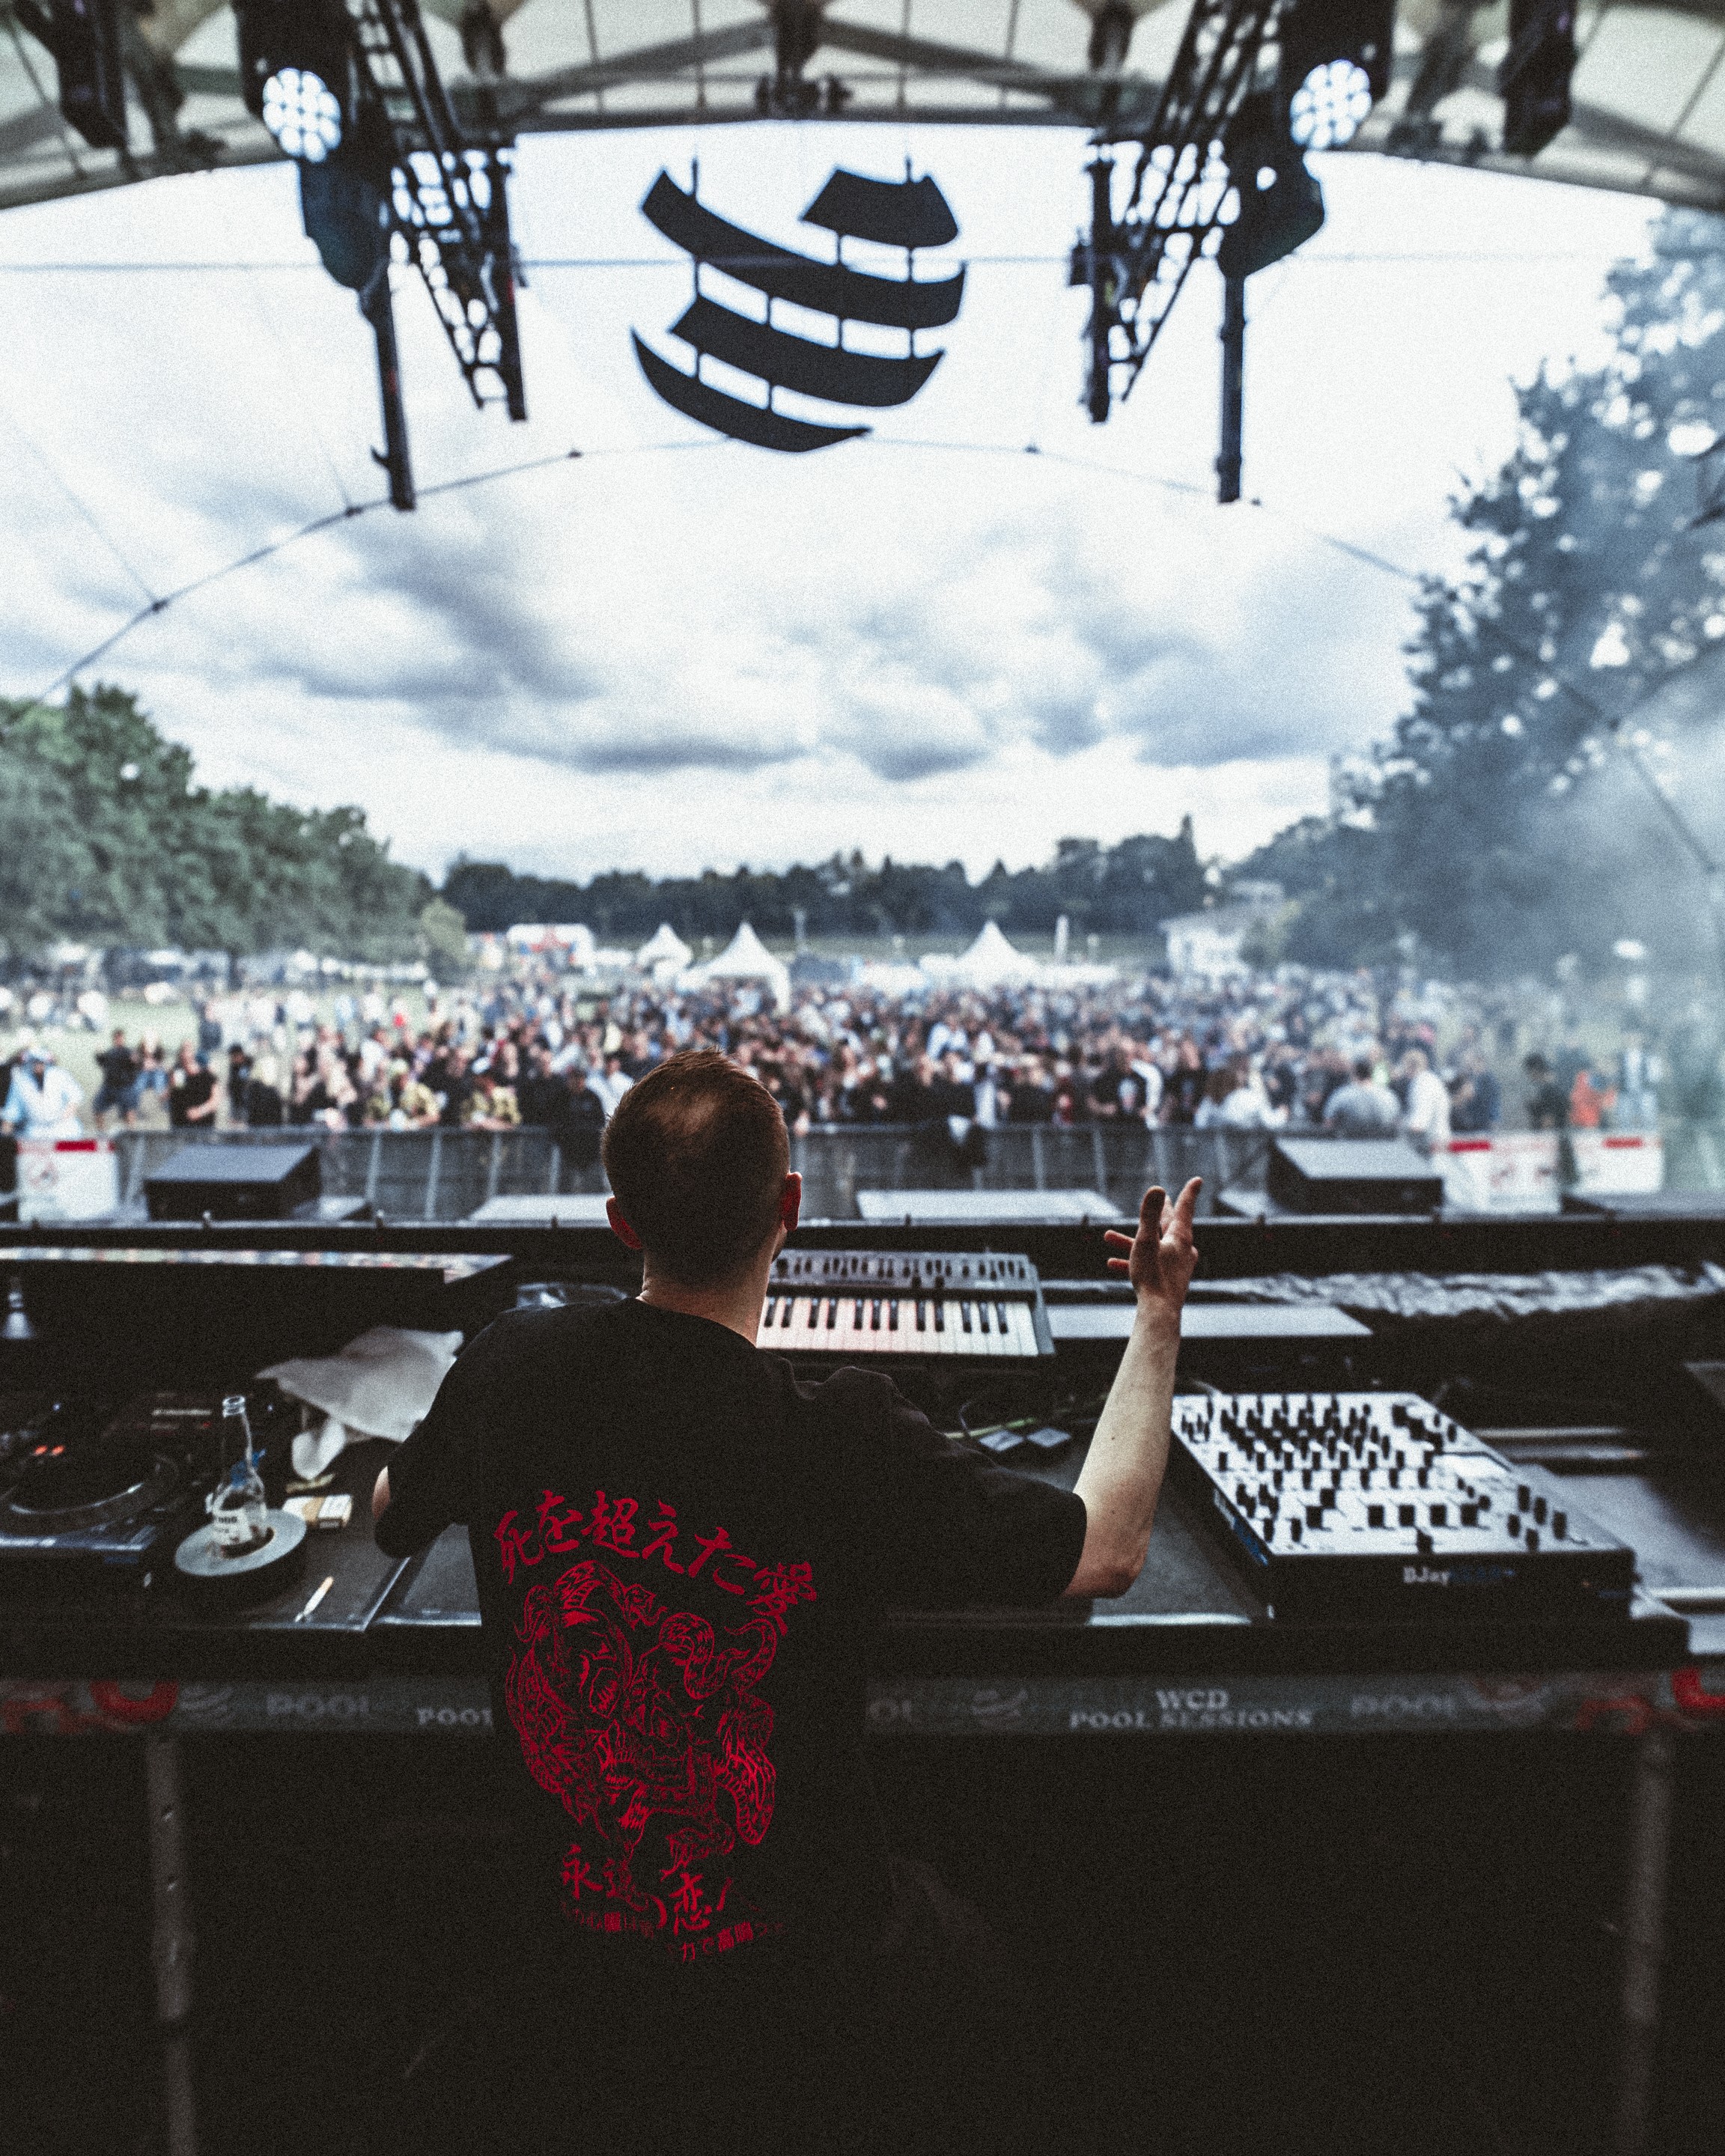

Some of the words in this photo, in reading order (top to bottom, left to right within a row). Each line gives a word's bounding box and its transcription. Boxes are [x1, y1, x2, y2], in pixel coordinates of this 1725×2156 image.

[1155, 1690, 1229, 1711] WCD
[1068, 1711, 1149, 1729] POOL
[1160, 1708, 1313, 1729] SESSIONS
